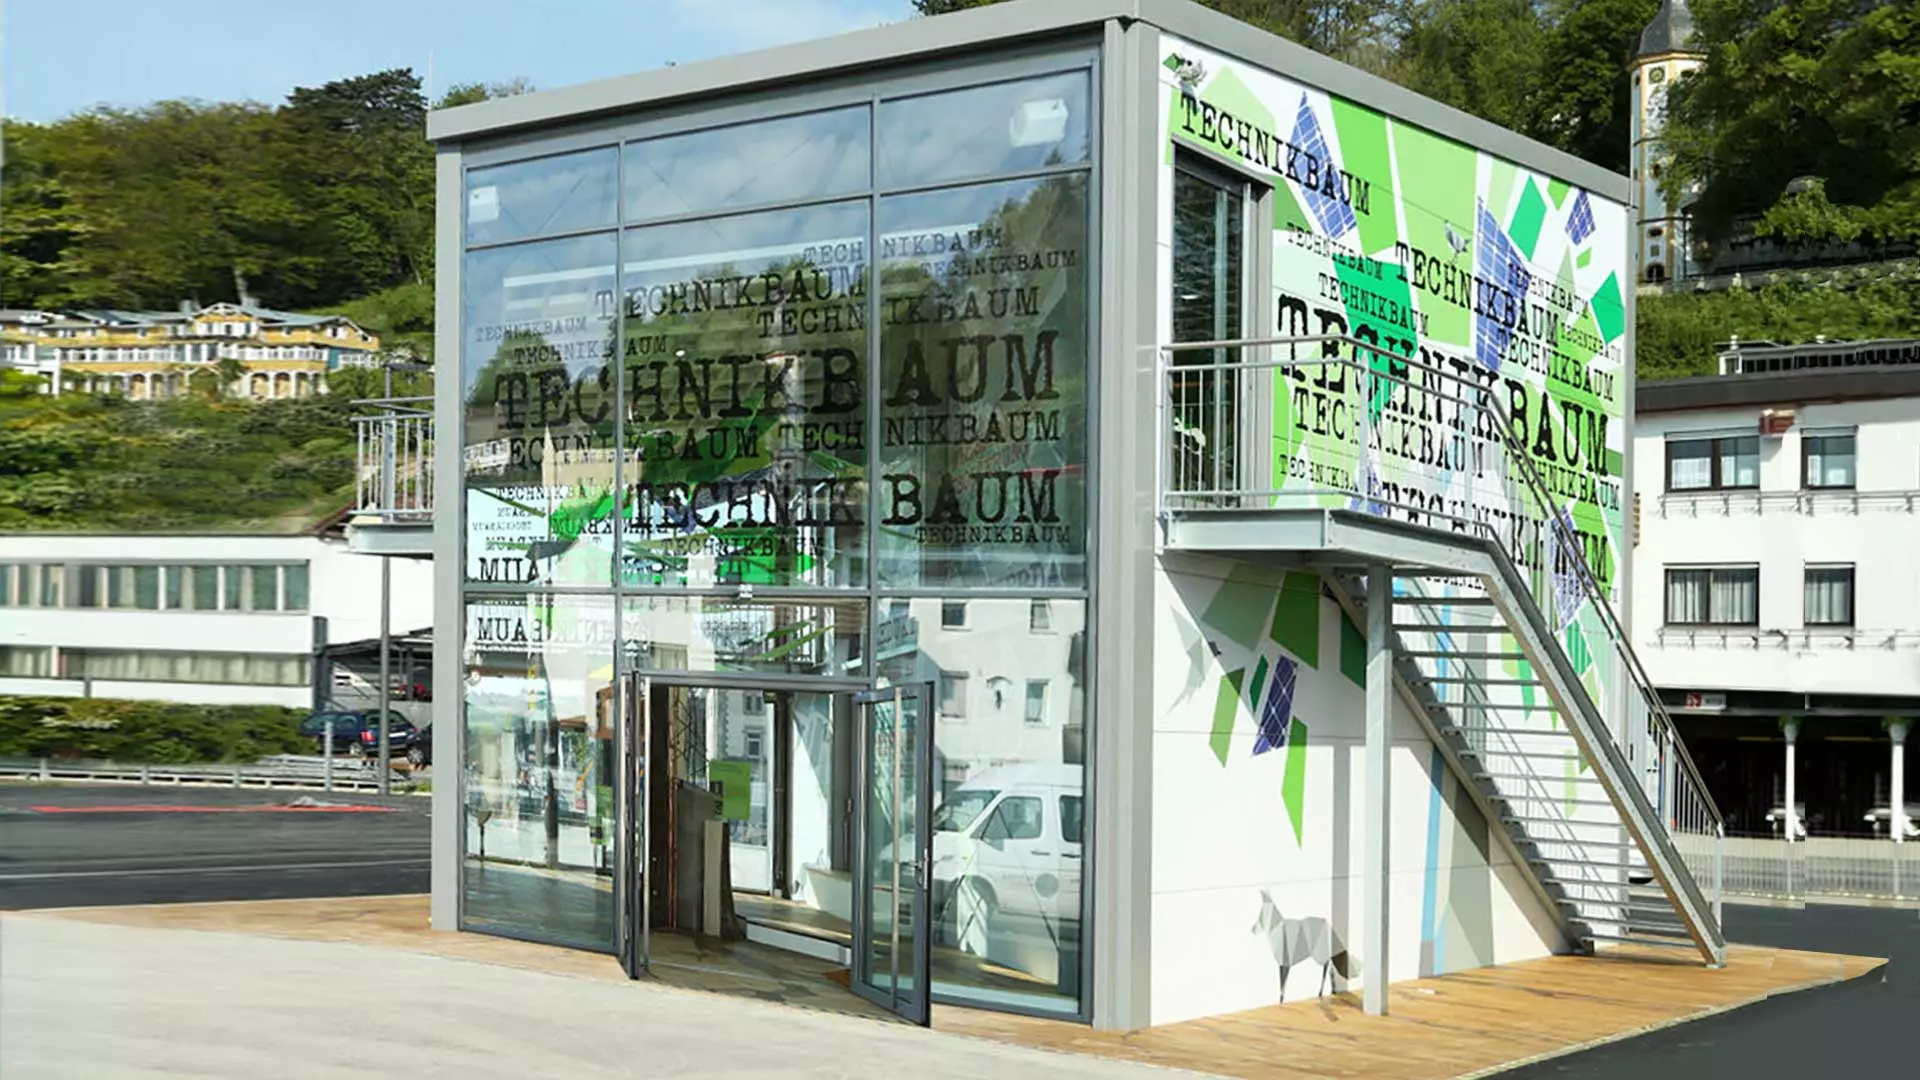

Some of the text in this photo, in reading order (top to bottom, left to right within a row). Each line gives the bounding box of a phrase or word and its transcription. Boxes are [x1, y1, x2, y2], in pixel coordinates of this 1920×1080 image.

[1181, 91, 1370, 216] TECHNIKBAUM
[595, 264, 866, 321] TECHNIKBAUM
[1318, 272, 1430, 338] TECHNIKBAUM
[1395, 240, 1559, 349] TECHNIKBAUM
[494, 329, 1061, 430] TECHNIKBAUM
